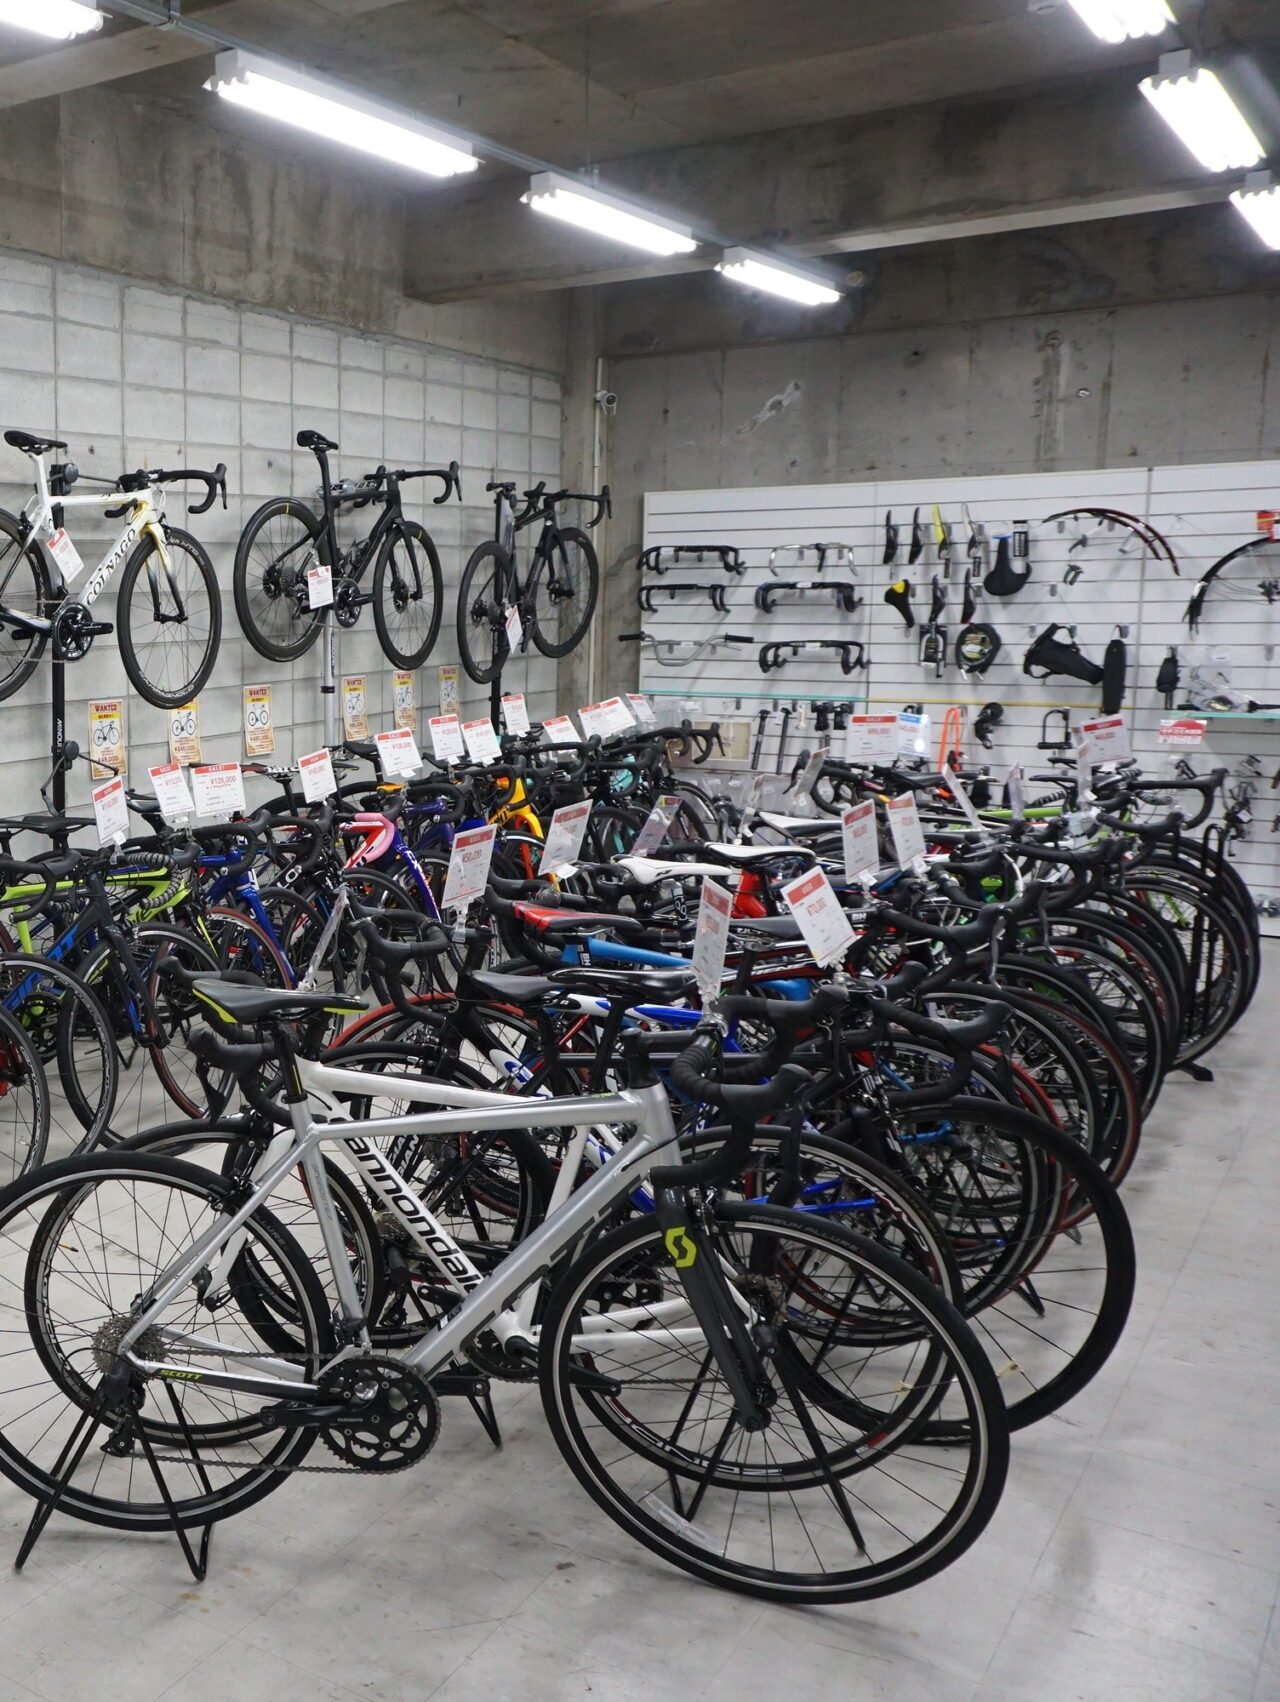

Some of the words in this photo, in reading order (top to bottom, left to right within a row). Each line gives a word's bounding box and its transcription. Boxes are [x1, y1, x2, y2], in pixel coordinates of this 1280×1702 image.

[86, 528, 136, 606] COLNAGO
[95, 703, 117, 712] WANTED
[160, 1369, 202, 1380] SCOTT
